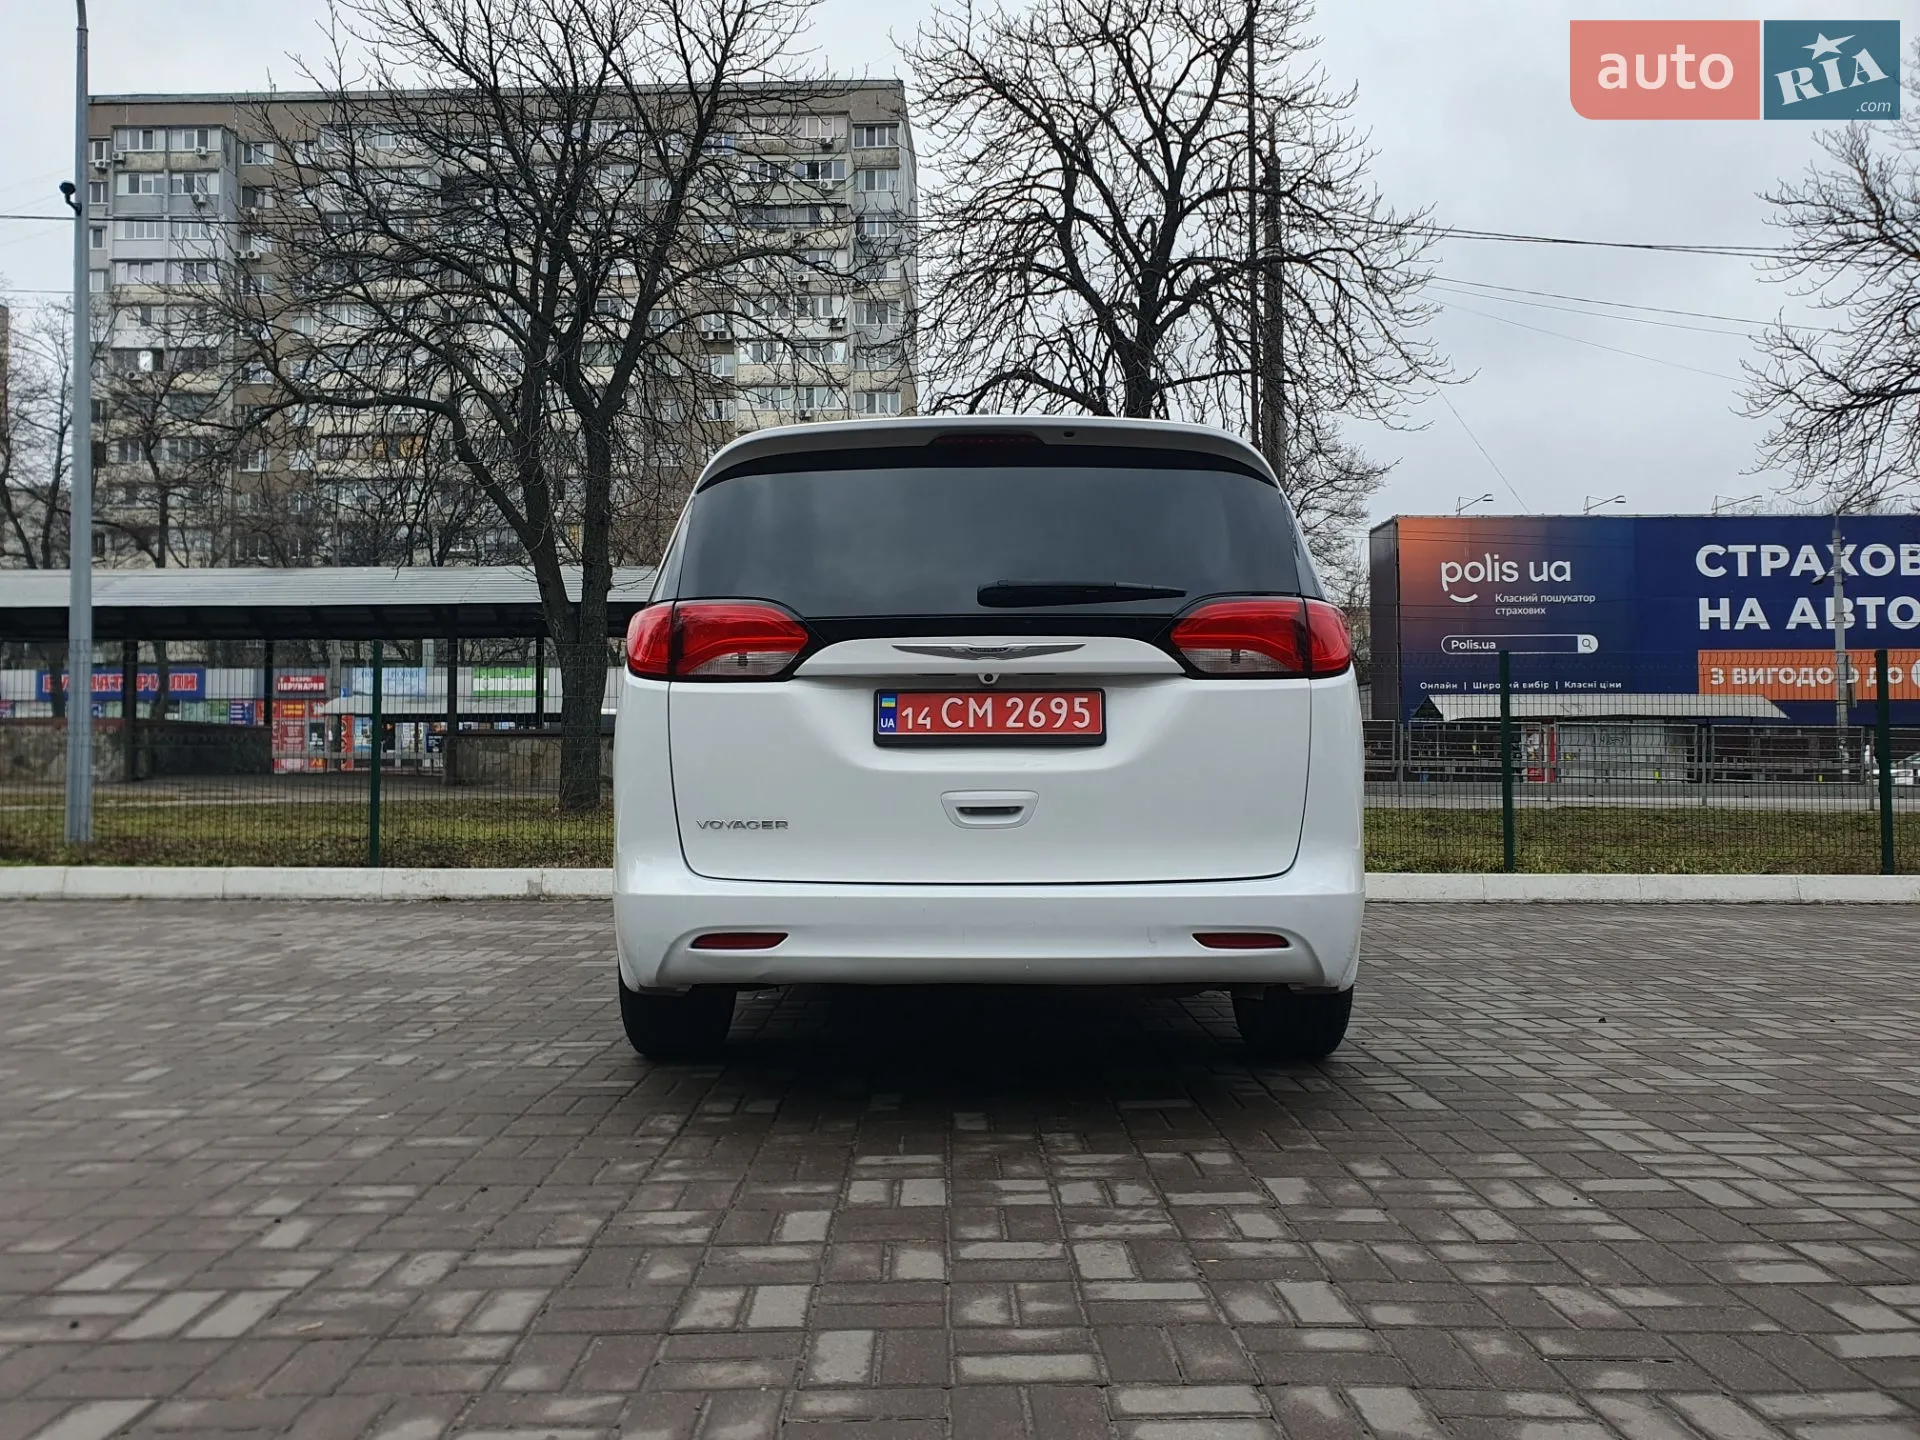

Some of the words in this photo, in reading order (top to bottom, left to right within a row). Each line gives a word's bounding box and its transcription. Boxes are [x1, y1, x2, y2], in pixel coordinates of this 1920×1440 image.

[1695, 543, 1920, 578] СТРАХОВ
[1440, 552, 1519, 592] polis
[1529, 560, 1571, 583] ua
[1495, 593, 1538, 603] Класний
[1541, 594, 1596, 605] пошукатор
[1495, 607, 1546, 617] страхових
[1698, 597, 1771, 631] НА
[1785, 595, 1920, 631] АВТО
[1451, 639, 1497, 650] Polis.ua
[1419, 681, 1458, 690] Онлайн
[1472, 681, 1520, 690] Широй
[1522, 680, 1550, 690] вибір
[1564, 680, 1597, 689] Класні
[1599, 680, 1622, 690] ціни
[902, 706, 931, 729] 14
[1005, 697, 1091, 729] 2695
[880, 718, 895, 729] UA
[696, 819, 789, 830] VOYAGER
